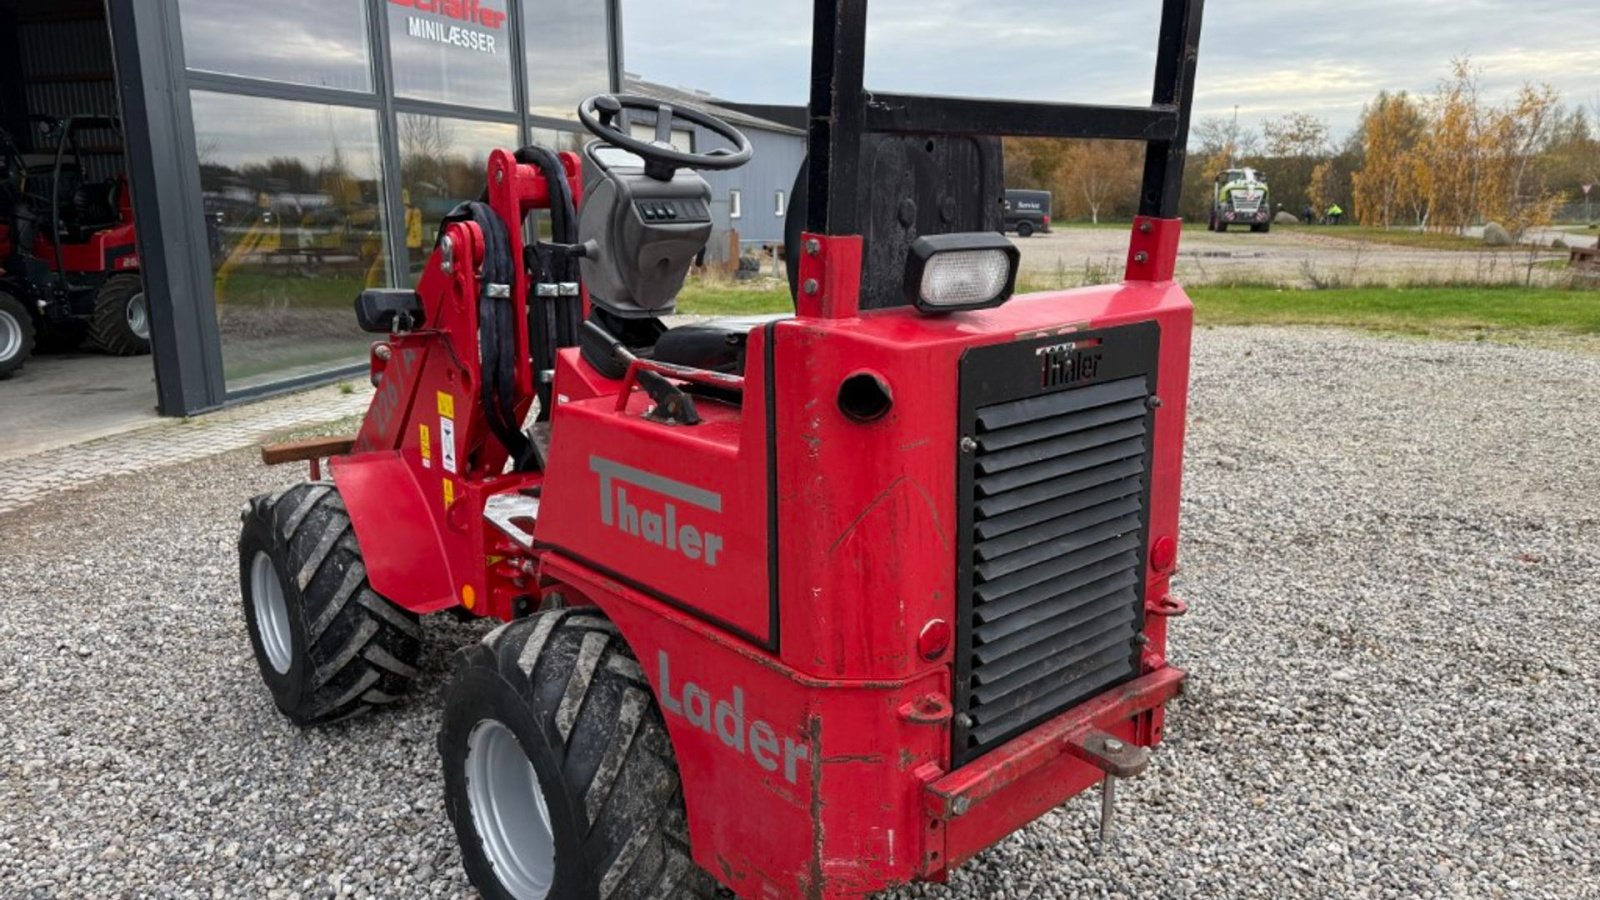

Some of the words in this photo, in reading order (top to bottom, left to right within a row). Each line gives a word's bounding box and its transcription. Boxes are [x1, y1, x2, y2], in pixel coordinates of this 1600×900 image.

[409, 16, 496, 54] MINILÆSSER
[1036, 338, 1102, 388] Thaler
[589, 454, 723, 566] Thaler
